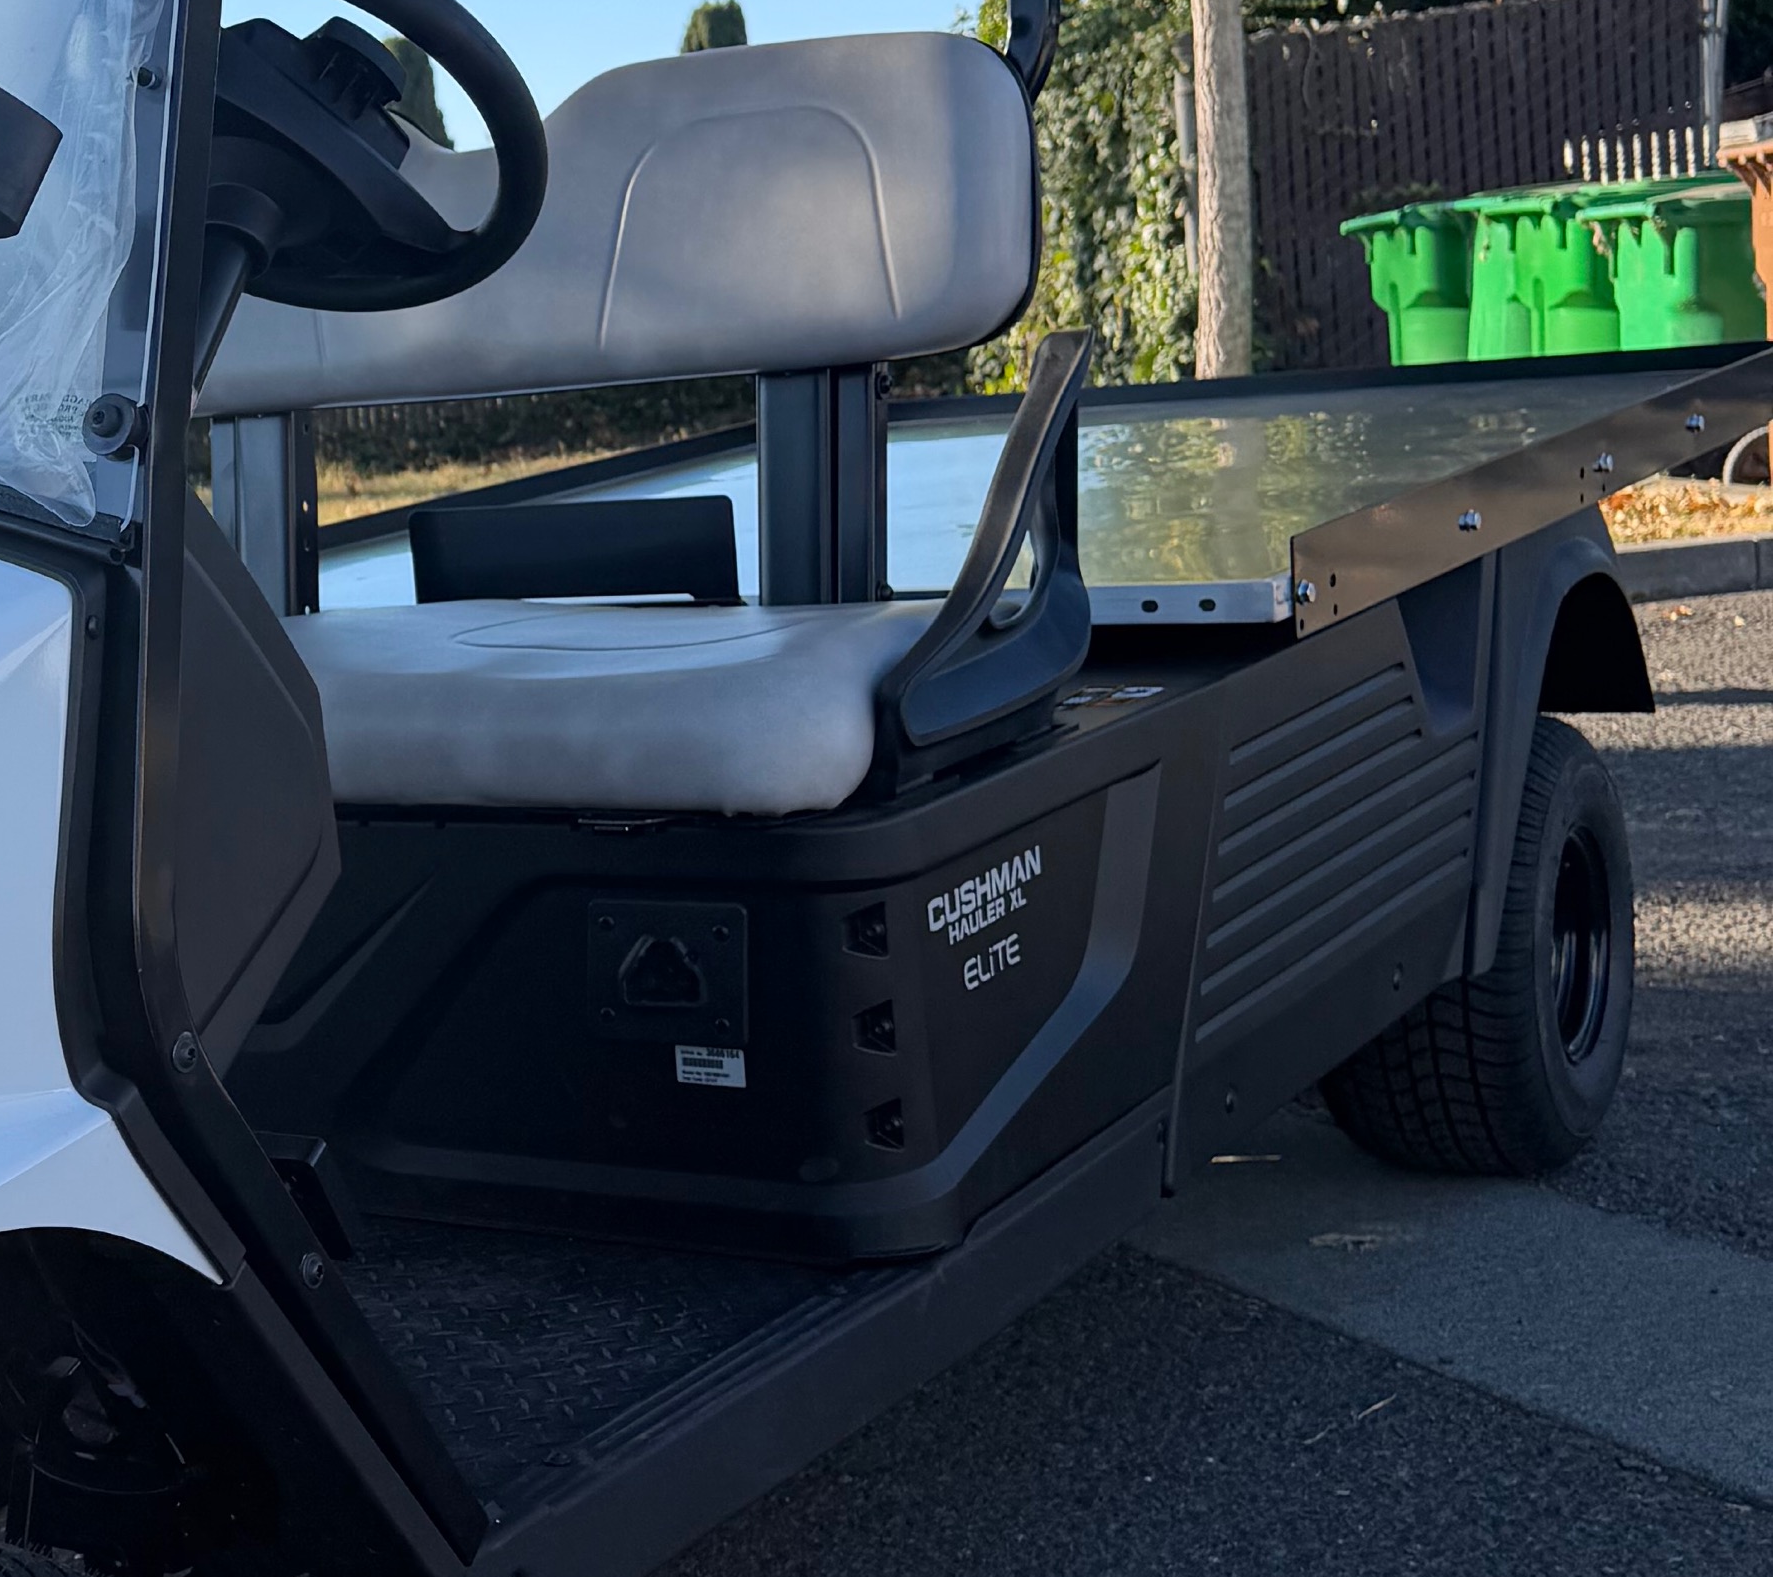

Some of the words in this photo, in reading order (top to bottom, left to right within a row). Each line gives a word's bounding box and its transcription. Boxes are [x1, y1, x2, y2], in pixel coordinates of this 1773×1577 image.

[927, 845, 1041, 932] CUSHMAN
[948, 897, 1006, 945] HAULER
[1009, 887, 1027, 911] XL
